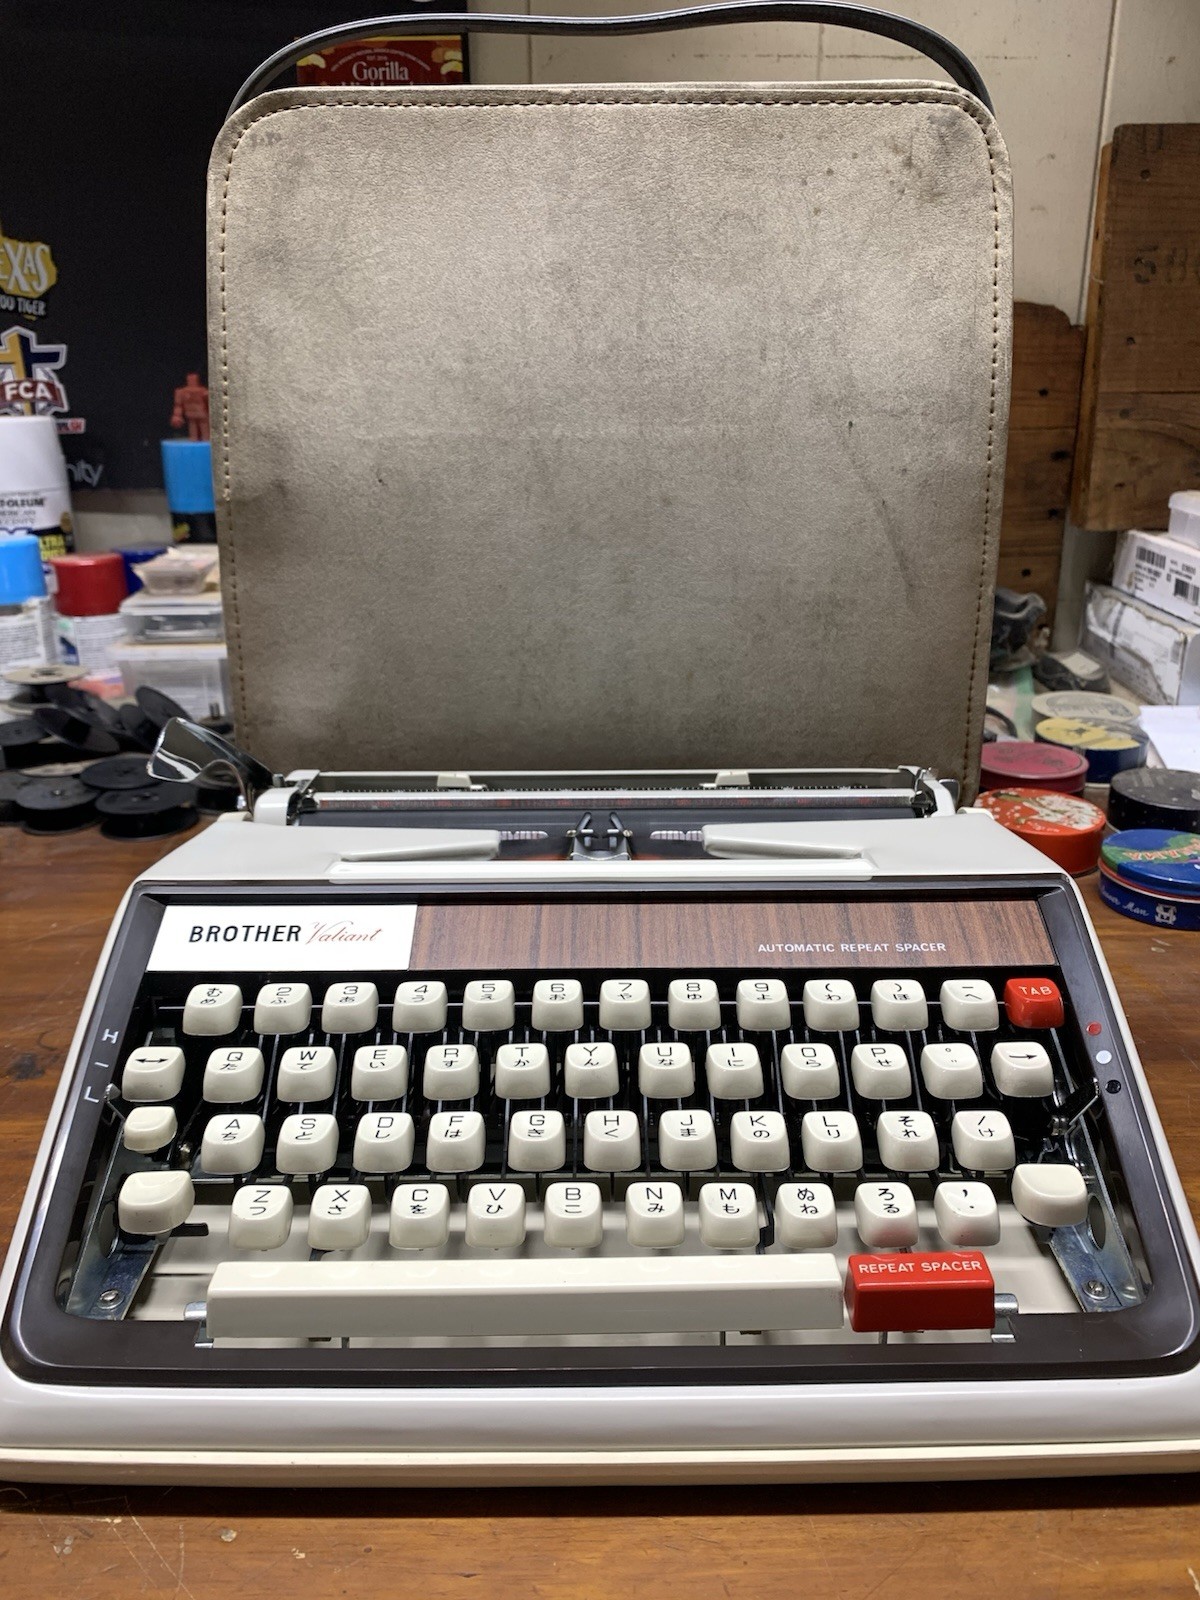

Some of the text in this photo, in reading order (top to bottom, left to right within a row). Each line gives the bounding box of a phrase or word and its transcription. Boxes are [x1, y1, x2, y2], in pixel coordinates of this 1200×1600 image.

[352, 61, 409, 81] Gorilla
[17, 297, 46, 316] TIGER
[5, 382, 53, 401] FCA
[188, 920, 383, 945] BROTHER Valiant
[757, 942, 947, 953] AUTOMATIC REPEAT SPACER
[276, 986, 292, 997] 2
[343, 985, 359, 995] 3
[414, 984, 429, 994] 4
[481, 983, 496, 993] 5
[550, 983, 565, 993] 6
[618, 982, 632, 992] 7
[686, 982, 701, 992] 8
[1018, 984, 1052, 996] TAB
[226, 1051, 244, 1062] Q
[299, 1050, 318, 1061] W
[372, 1049, 388, 1060] E
[443, 1047, 459, 1058] R
[514, 1046, 530, 1057] T
[583, 1046, 599, 1057] Y
[657, 1046, 673, 1057] U
[801, 1047, 817, 1058] O
[870, 1047, 887, 1058] P
[225, 1118, 241, 1130] A
[299, 1117, 317, 1130] S
[377, 1116, 394, 1129] D
[449, 1115, 465, 1127] F
[529, 1114, 546, 1127] G
[603, 1115, 620, 1126] H
[680, 1114, 694, 1126] J
[749, 1115, 767, 1127] K
[822, 1115, 839, 1128] L
[375, 1129, 391, 1139] し
[444, 1129, 462, 1139] は
[753, 1129, 770, 1139] の
[827, 1129, 841, 1139] り
[901, 1128, 921, 1138] れ
[252, 1189, 272, 1203] Z
[331, 1189, 351, 1203] X
[412, 1188, 429, 1202] C
[488, 1187, 507, 1201] V
[565, 1187, 582, 1201] B
[645, 1186, 664, 1200] N
[719, 1187, 737, 1201] M
[797, 1187, 816, 1202] ぬ
[878, 1187, 895, 1201] ろ
[249, 1206, 267, 1216] つ
[327, 1204, 347, 1216] さ
[485, 1203, 504, 1215] ひ
[646, 1202, 666, 1213] み
[722, 1203, 740, 1215] も
[799, 1203, 819, 1215] ね
[882, 1203, 901, 1214] る
[858, 1260, 983, 1274] REPEAT SPACER
